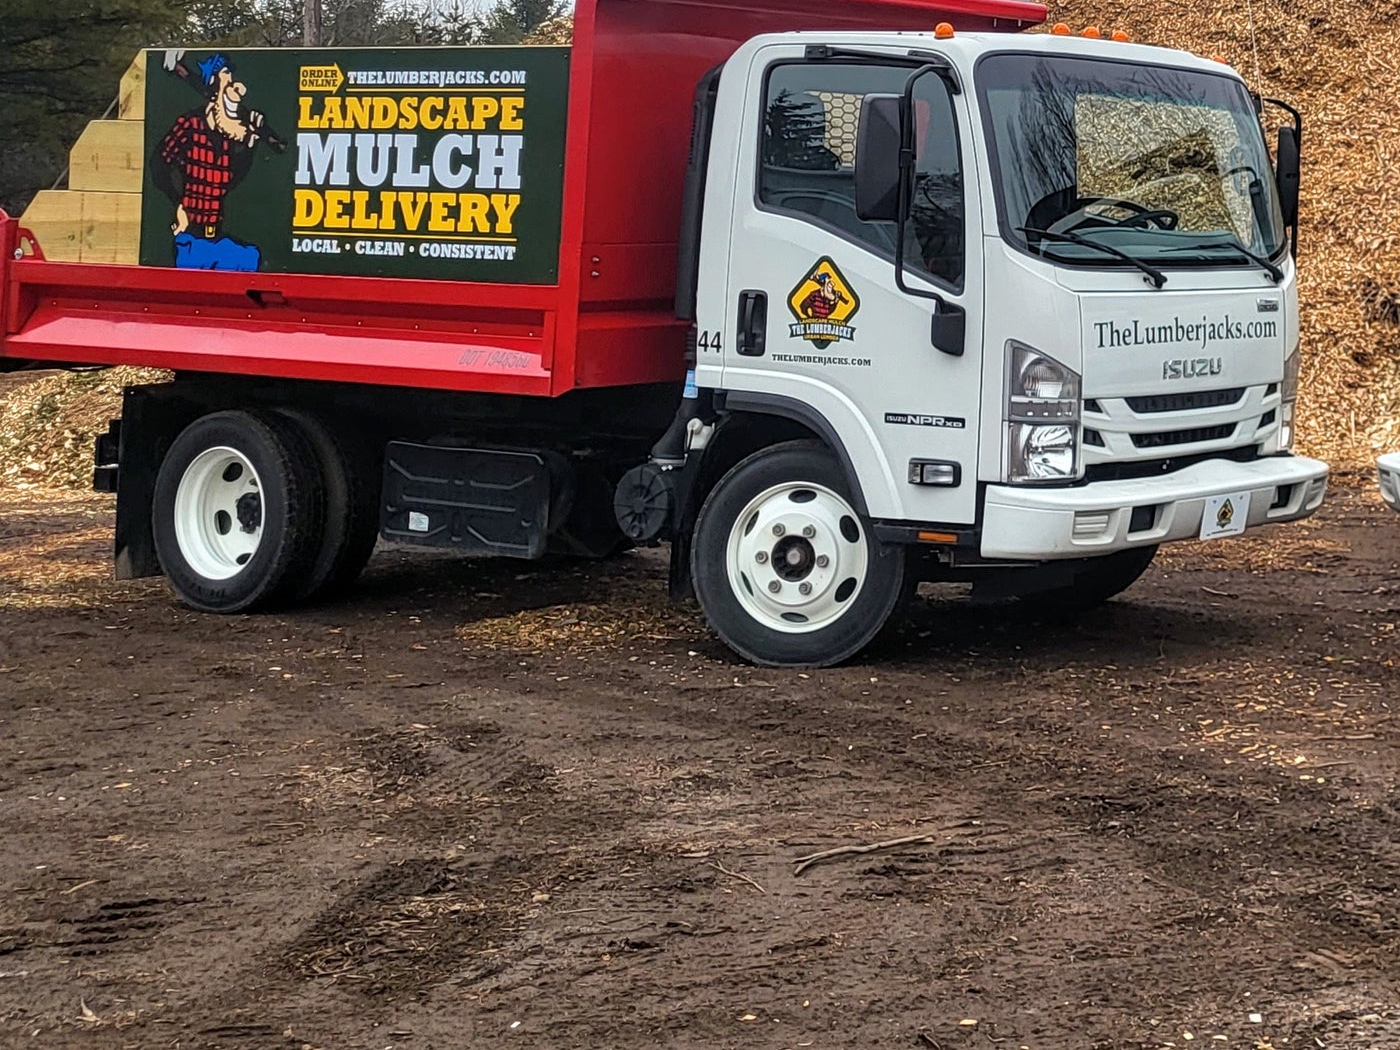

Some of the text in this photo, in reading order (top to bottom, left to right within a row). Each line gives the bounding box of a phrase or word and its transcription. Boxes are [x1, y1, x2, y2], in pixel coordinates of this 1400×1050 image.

[301, 69, 338, 79] ORDER
[301, 78, 338, 88] ONLINE
[347, 70, 527, 87] THELUMBERJACKS.COM
[298, 96, 525, 130] LANDSCAPE
[295, 132, 524, 189] MULCH
[292, 189, 521, 233] DELIVERY
[292, 238, 516, 261] LOCAL CLEAN CONSISTENT
[698, 330, 722, 353] 44
[1093, 314, 1277, 350] TheLumberjacks.com
[772, 353, 871, 366] THELUMBERJACKS.COM
[1162, 357, 1222, 380] ISUZU
